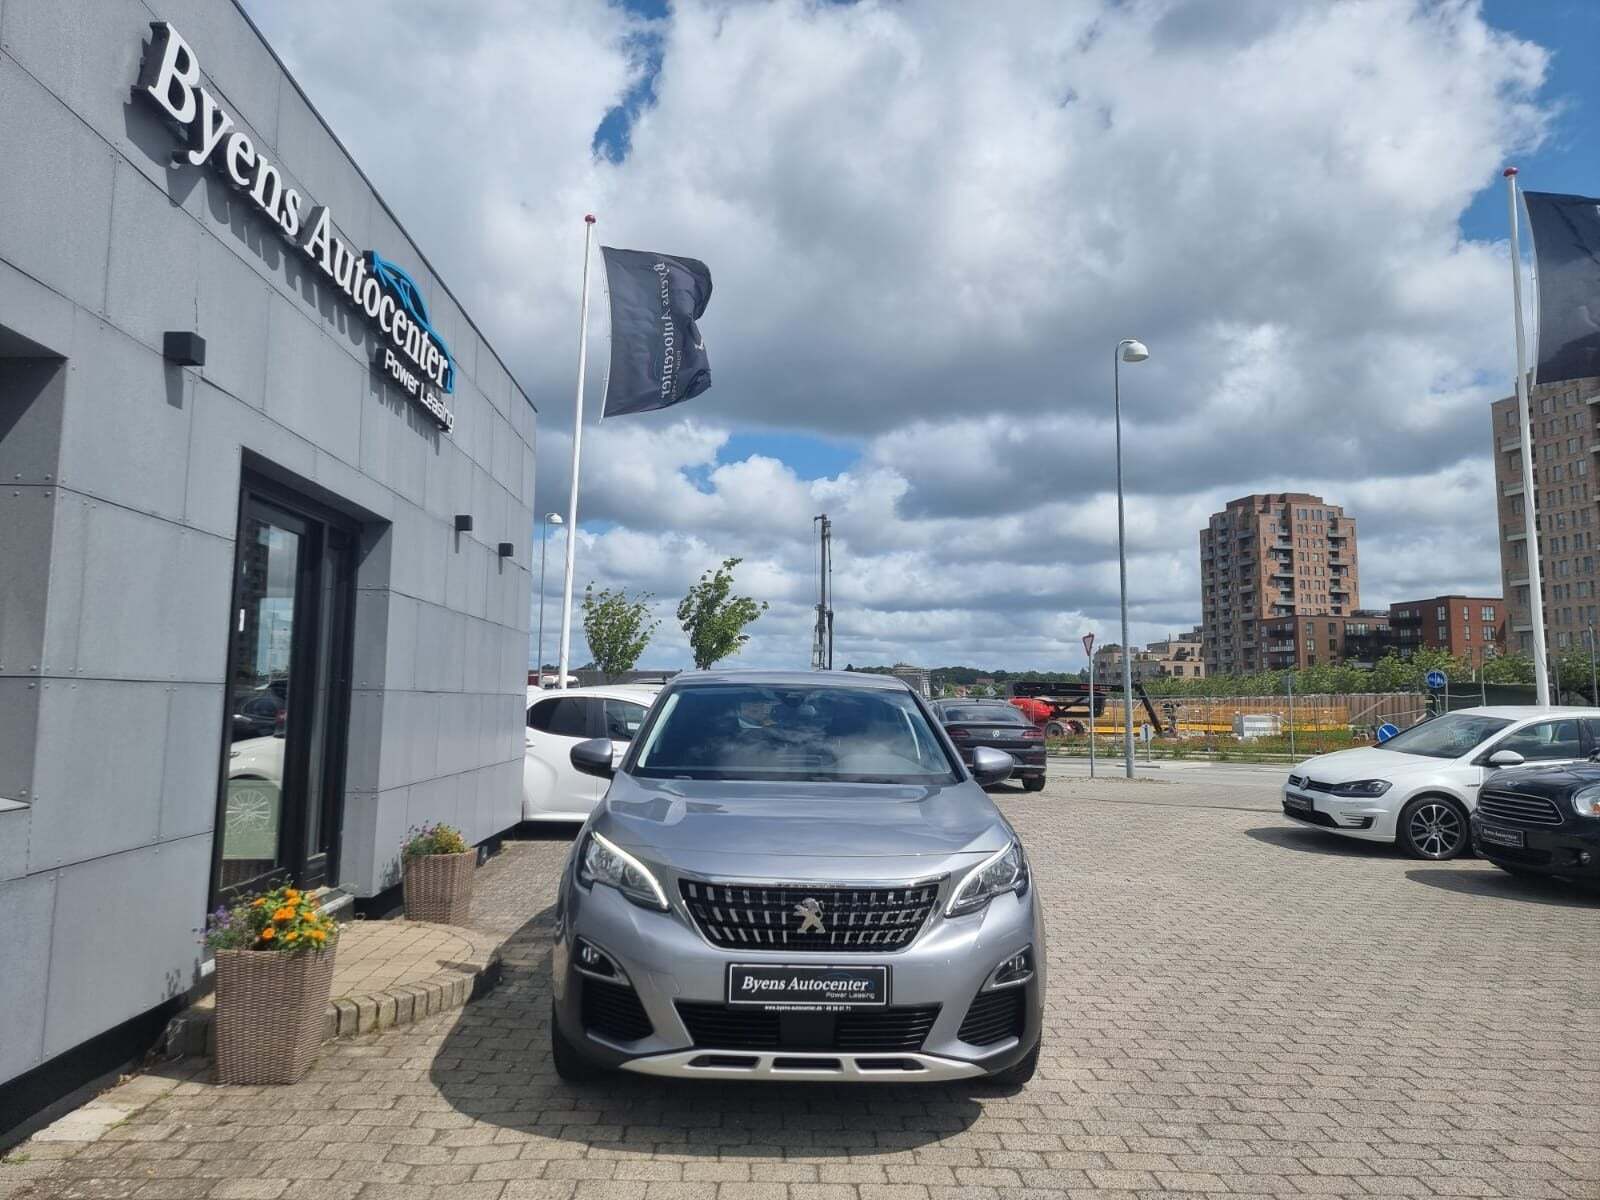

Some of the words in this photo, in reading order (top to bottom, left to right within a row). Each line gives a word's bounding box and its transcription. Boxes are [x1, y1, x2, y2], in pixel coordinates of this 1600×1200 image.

[148, 22, 301, 236] Byens
[304, 207, 448, 388] Autocenter
[384, 349, 420, 395] Power
[420, 382, 455, 434] Leasing
[742, 976, 786, 992] Byens
[788, 977, 869, 991] Autocenter
